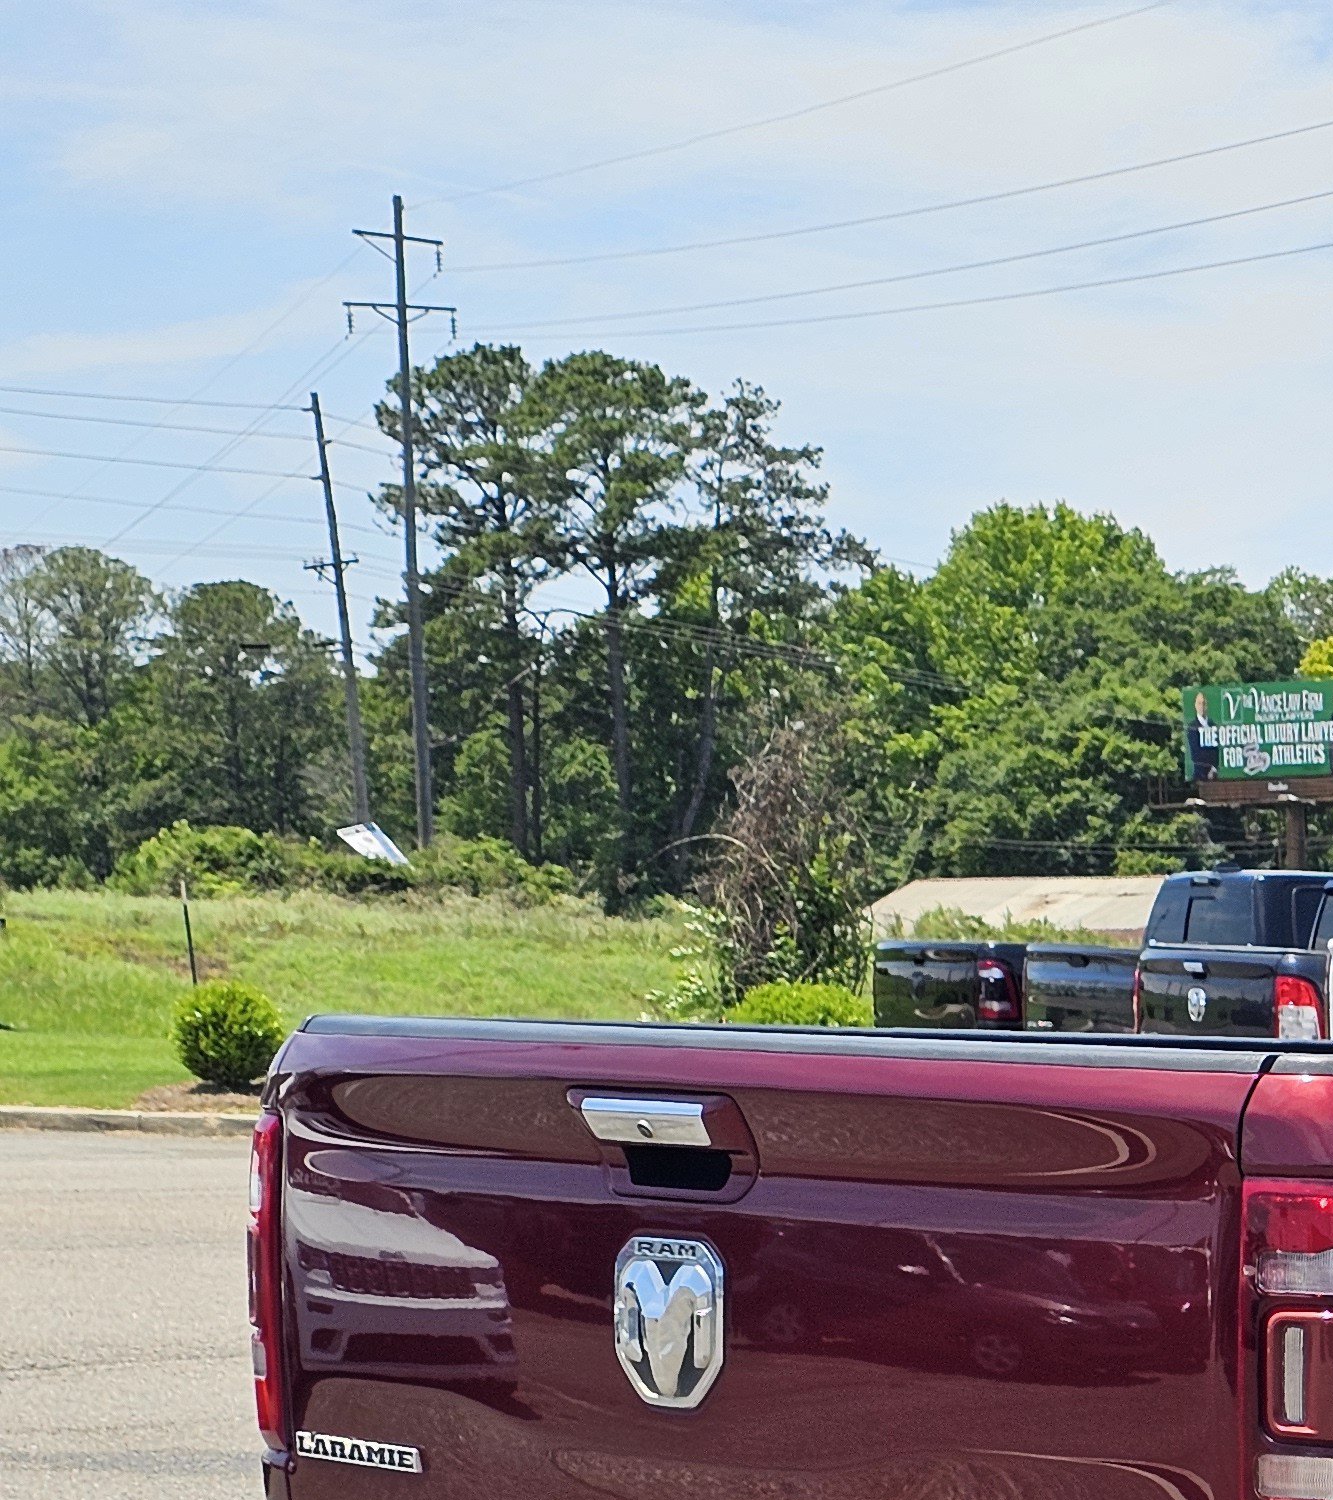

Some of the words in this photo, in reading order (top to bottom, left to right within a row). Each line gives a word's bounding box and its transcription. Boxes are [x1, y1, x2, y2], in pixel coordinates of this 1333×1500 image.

[1282, 690, 1300, 712] LAW
[1198, 725, 1219, 747] THE
[1219, 723, 1263, 746] OFFICIAL
[1264, 722, 1299, 744] INJURY
[1223, 746, 1244, 768] FOR
[1272, 743, 1325, 766] ATHLETICS
[636, 1241, 697, 1258] RAM
[296, 1431, 421, 1473] LARAMIE
